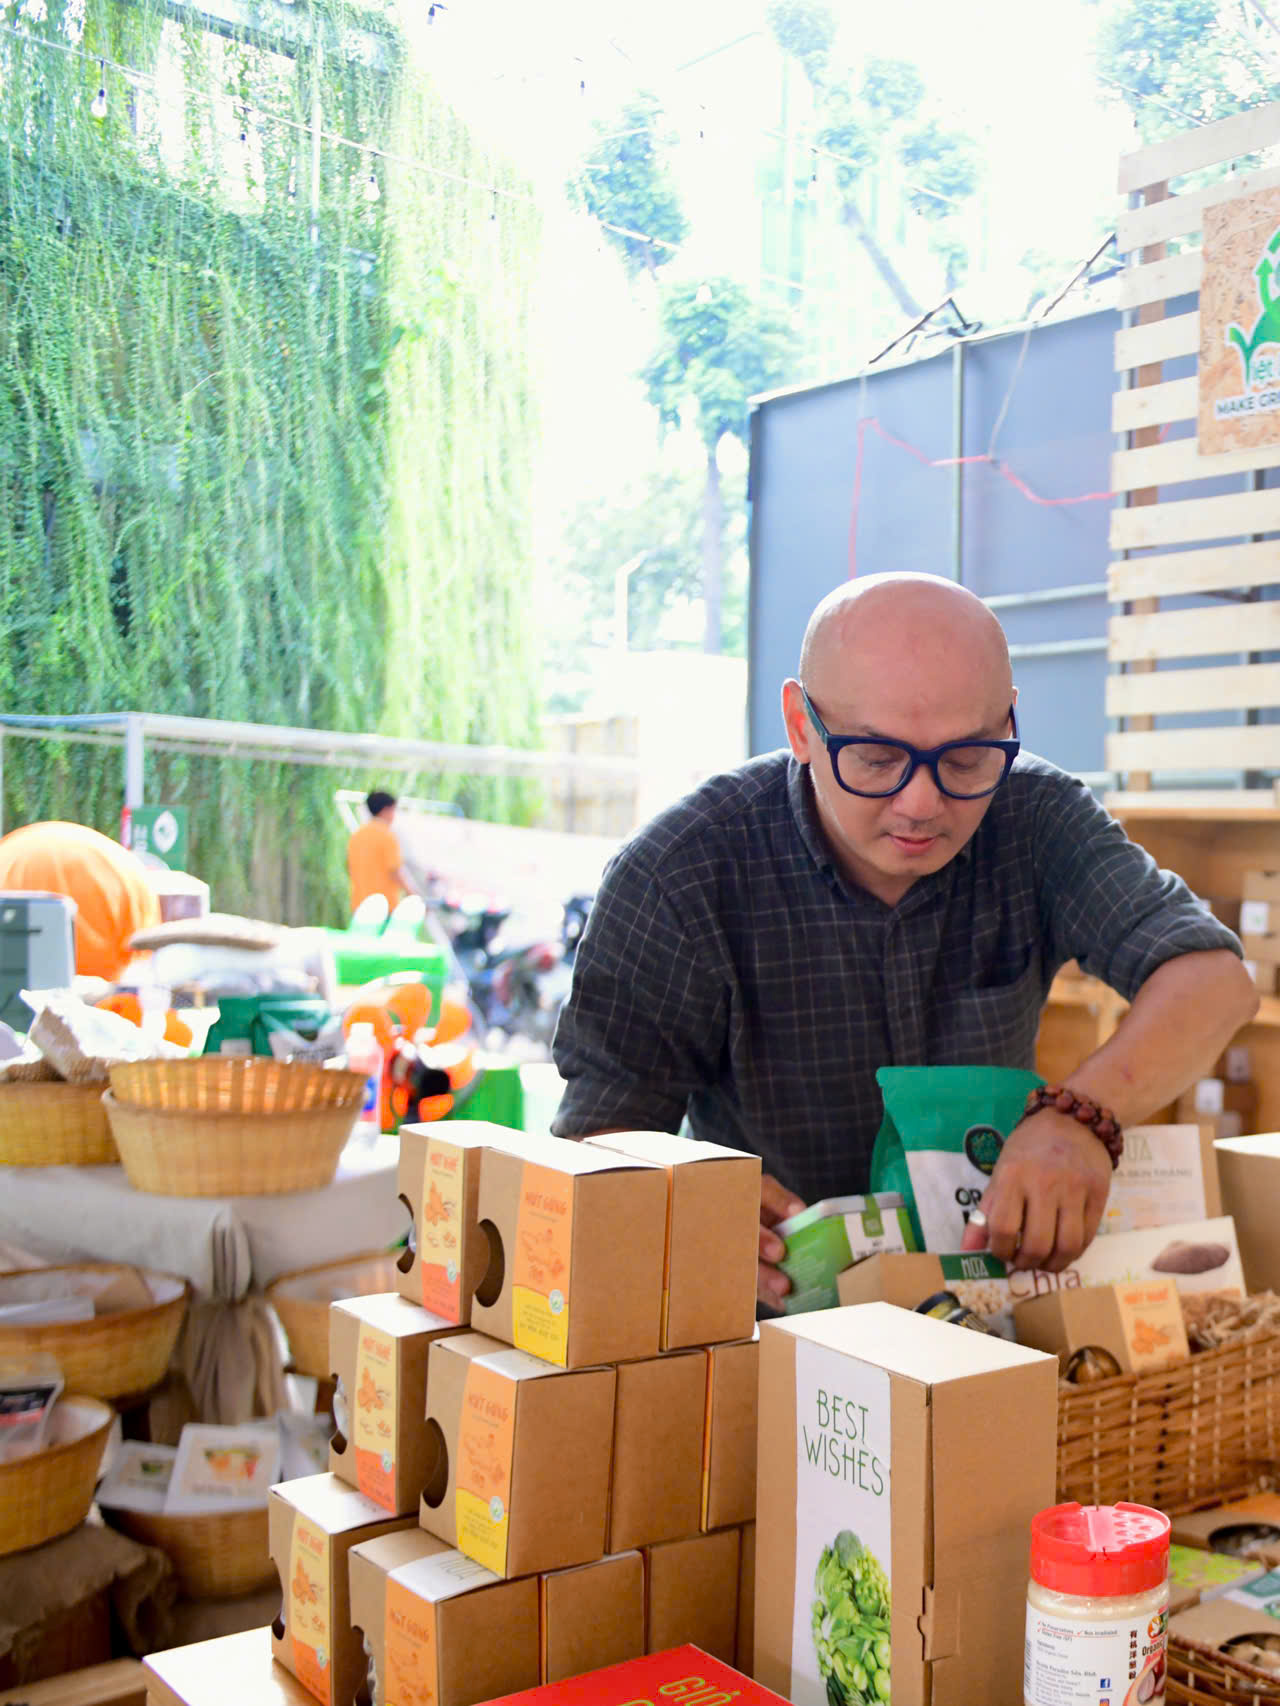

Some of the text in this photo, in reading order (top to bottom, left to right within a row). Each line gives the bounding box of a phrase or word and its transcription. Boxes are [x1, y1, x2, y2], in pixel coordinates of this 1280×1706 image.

[1217, 397, 1254, 415] MAKE
[817, 1389, 869, 1444] BEST
[803, 1425, 884, 1496] WISHES
